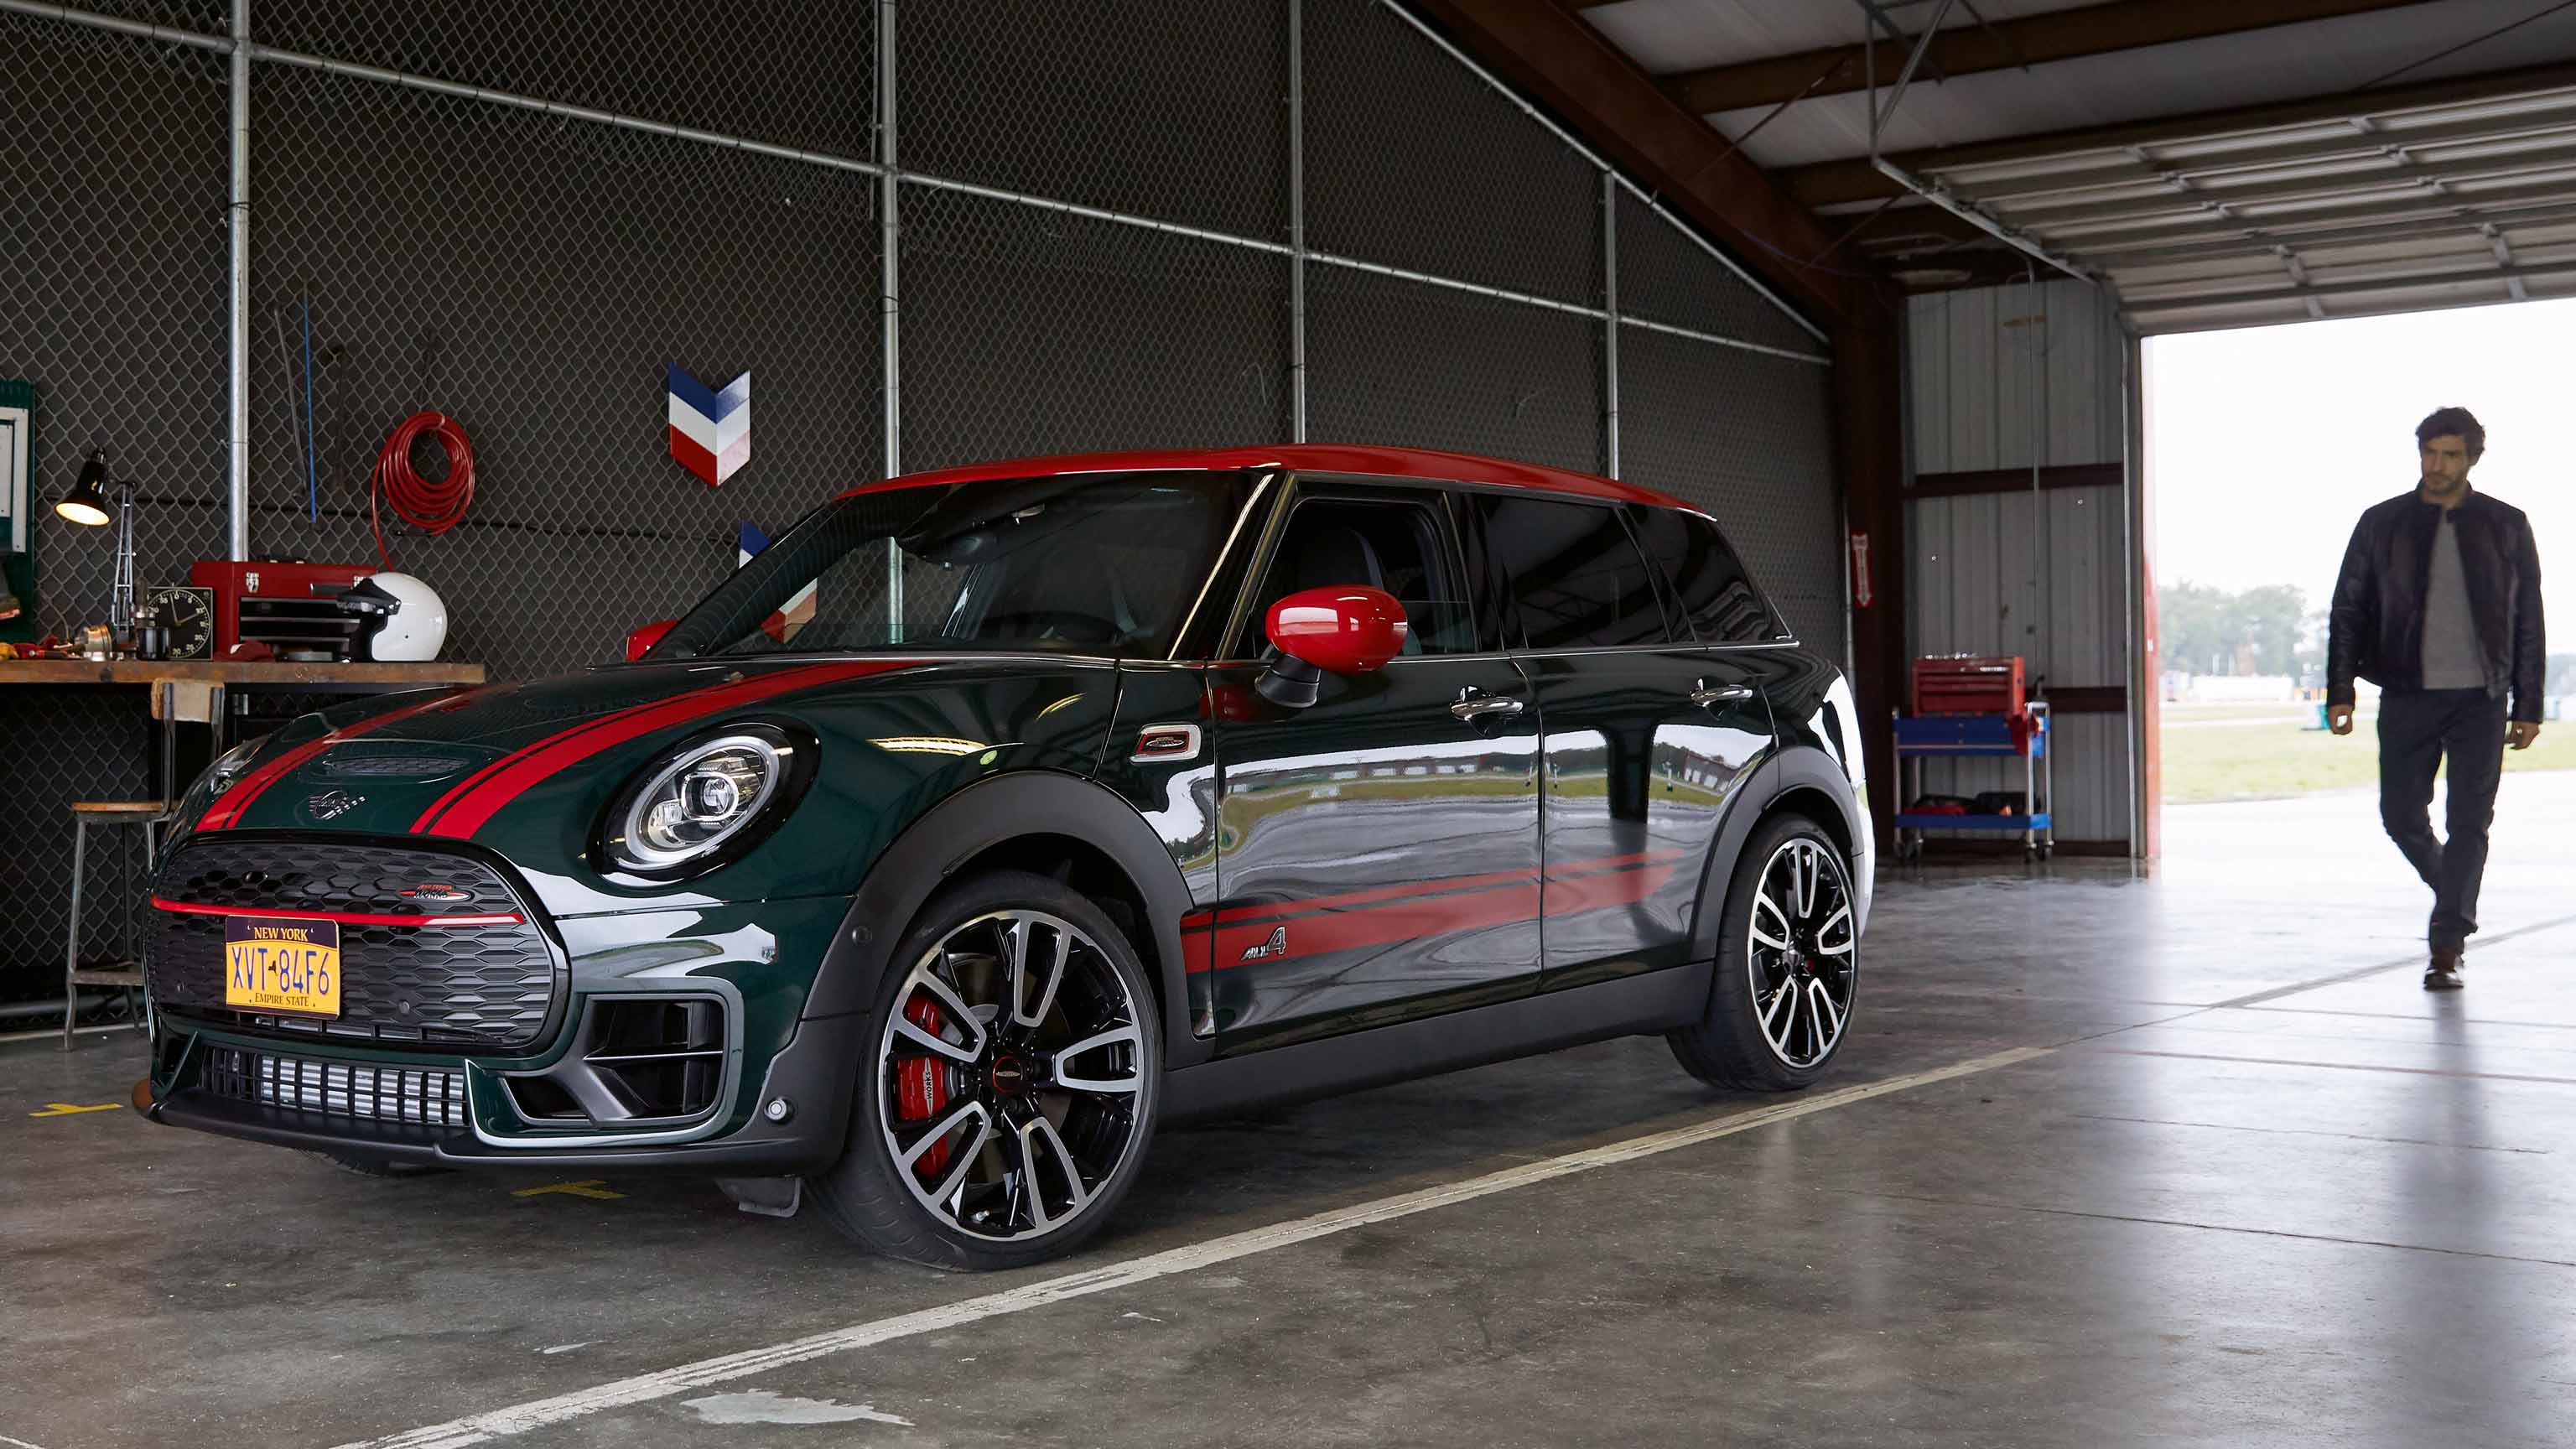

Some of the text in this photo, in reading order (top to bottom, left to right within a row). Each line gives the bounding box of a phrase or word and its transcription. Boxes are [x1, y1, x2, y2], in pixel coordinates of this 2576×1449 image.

[254, 927, 309, 942] NEW YORK
[255, 992, 309, 1007] EMPIRE STATE
